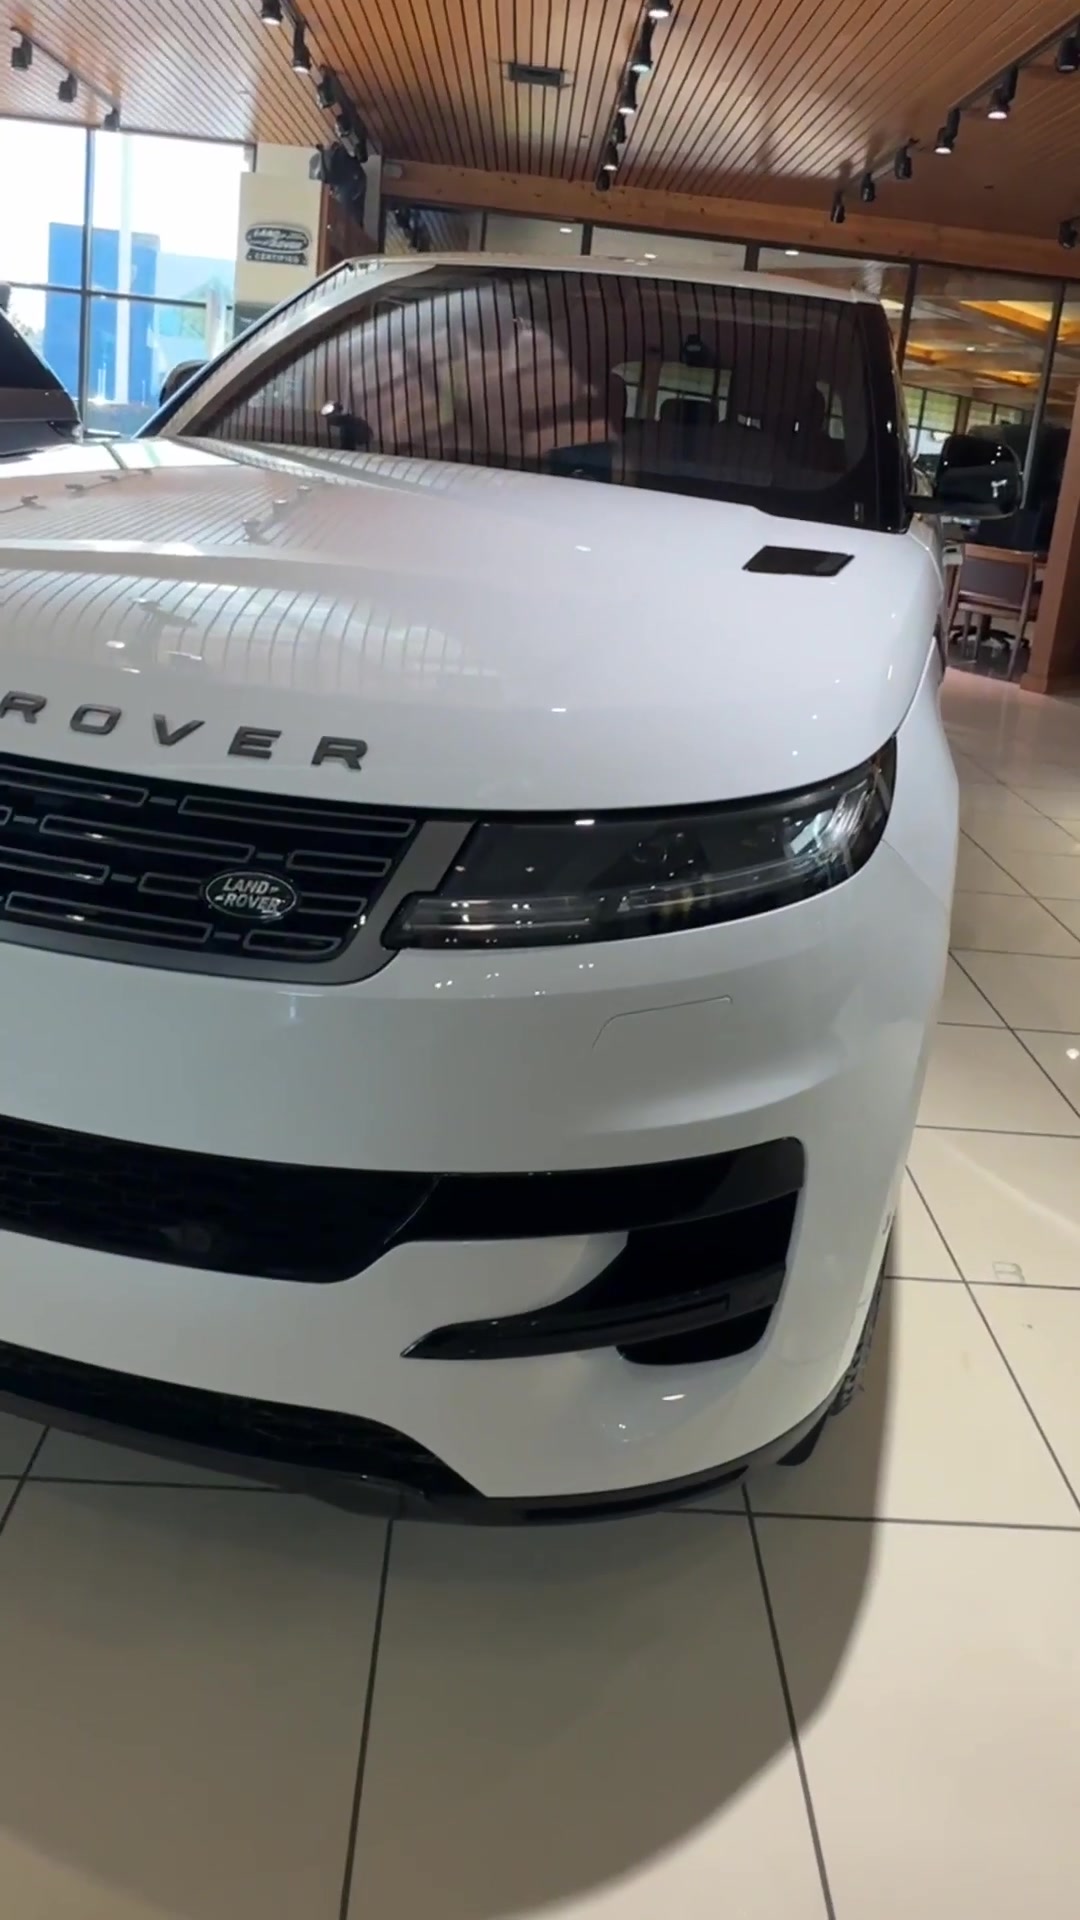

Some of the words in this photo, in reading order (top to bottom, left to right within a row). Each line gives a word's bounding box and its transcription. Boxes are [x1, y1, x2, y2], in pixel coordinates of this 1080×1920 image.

[253, 229, 281, 238] LAND
[254, 252, 300, 263] CERTIFIED
[0, 691, 368, 771] ROVER
[223, 878, 270, 895] LAND
[224, 893, 281, 914] ROVER
